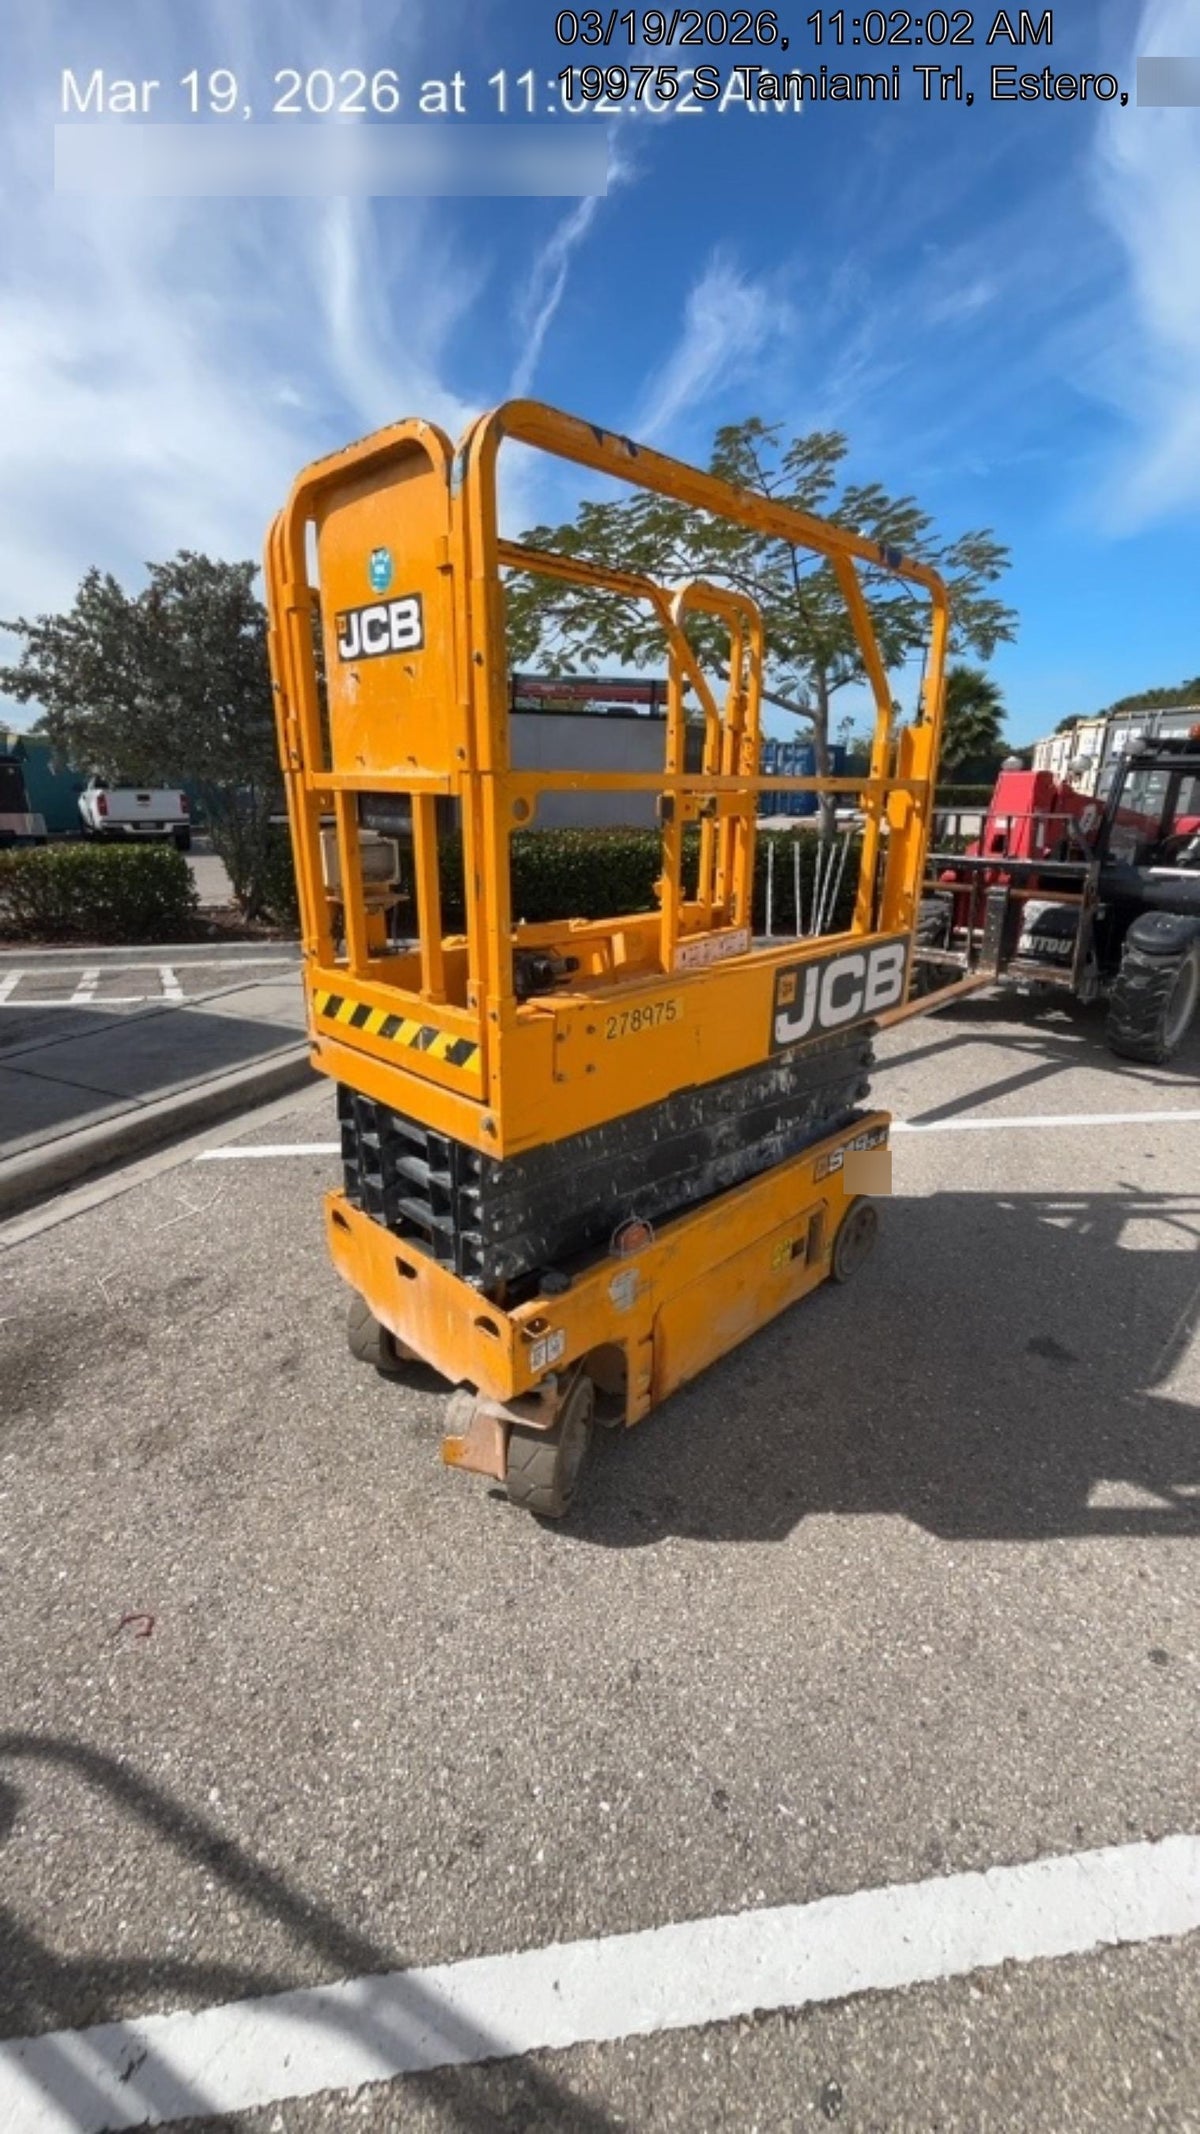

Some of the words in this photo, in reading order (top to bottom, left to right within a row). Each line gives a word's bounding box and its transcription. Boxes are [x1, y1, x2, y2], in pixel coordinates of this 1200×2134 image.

[339, 598, 421, 659] JCB
[605, 999, 677, 1040] 278975
[774, 942, 905, 1044] JCB
